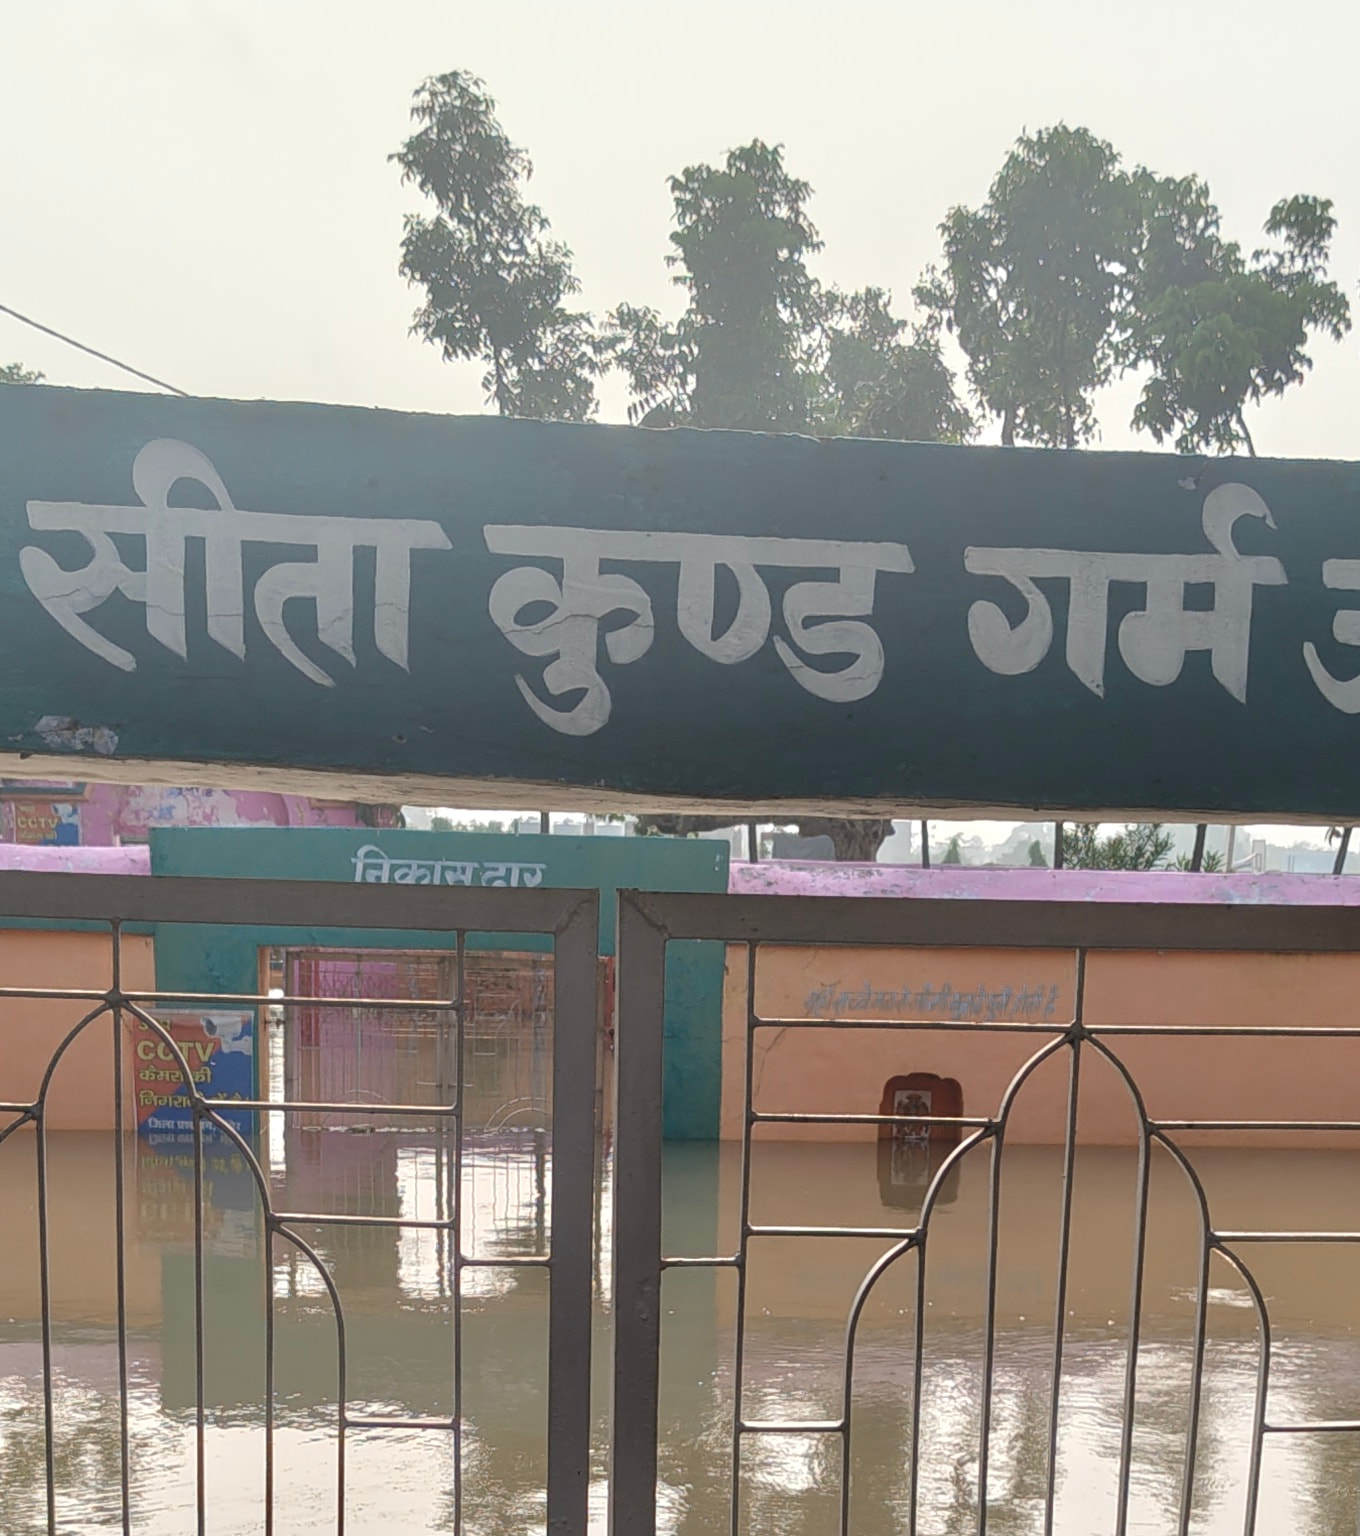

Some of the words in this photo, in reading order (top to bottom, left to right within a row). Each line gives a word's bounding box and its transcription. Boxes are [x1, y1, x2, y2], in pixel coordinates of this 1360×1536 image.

[20, 438, 452, 688] सीता
[483, 523, 915, 737] कुण्ड
[965, 483, 1287, 704] गर्म
[17, 816, 59, 829] CCTV
